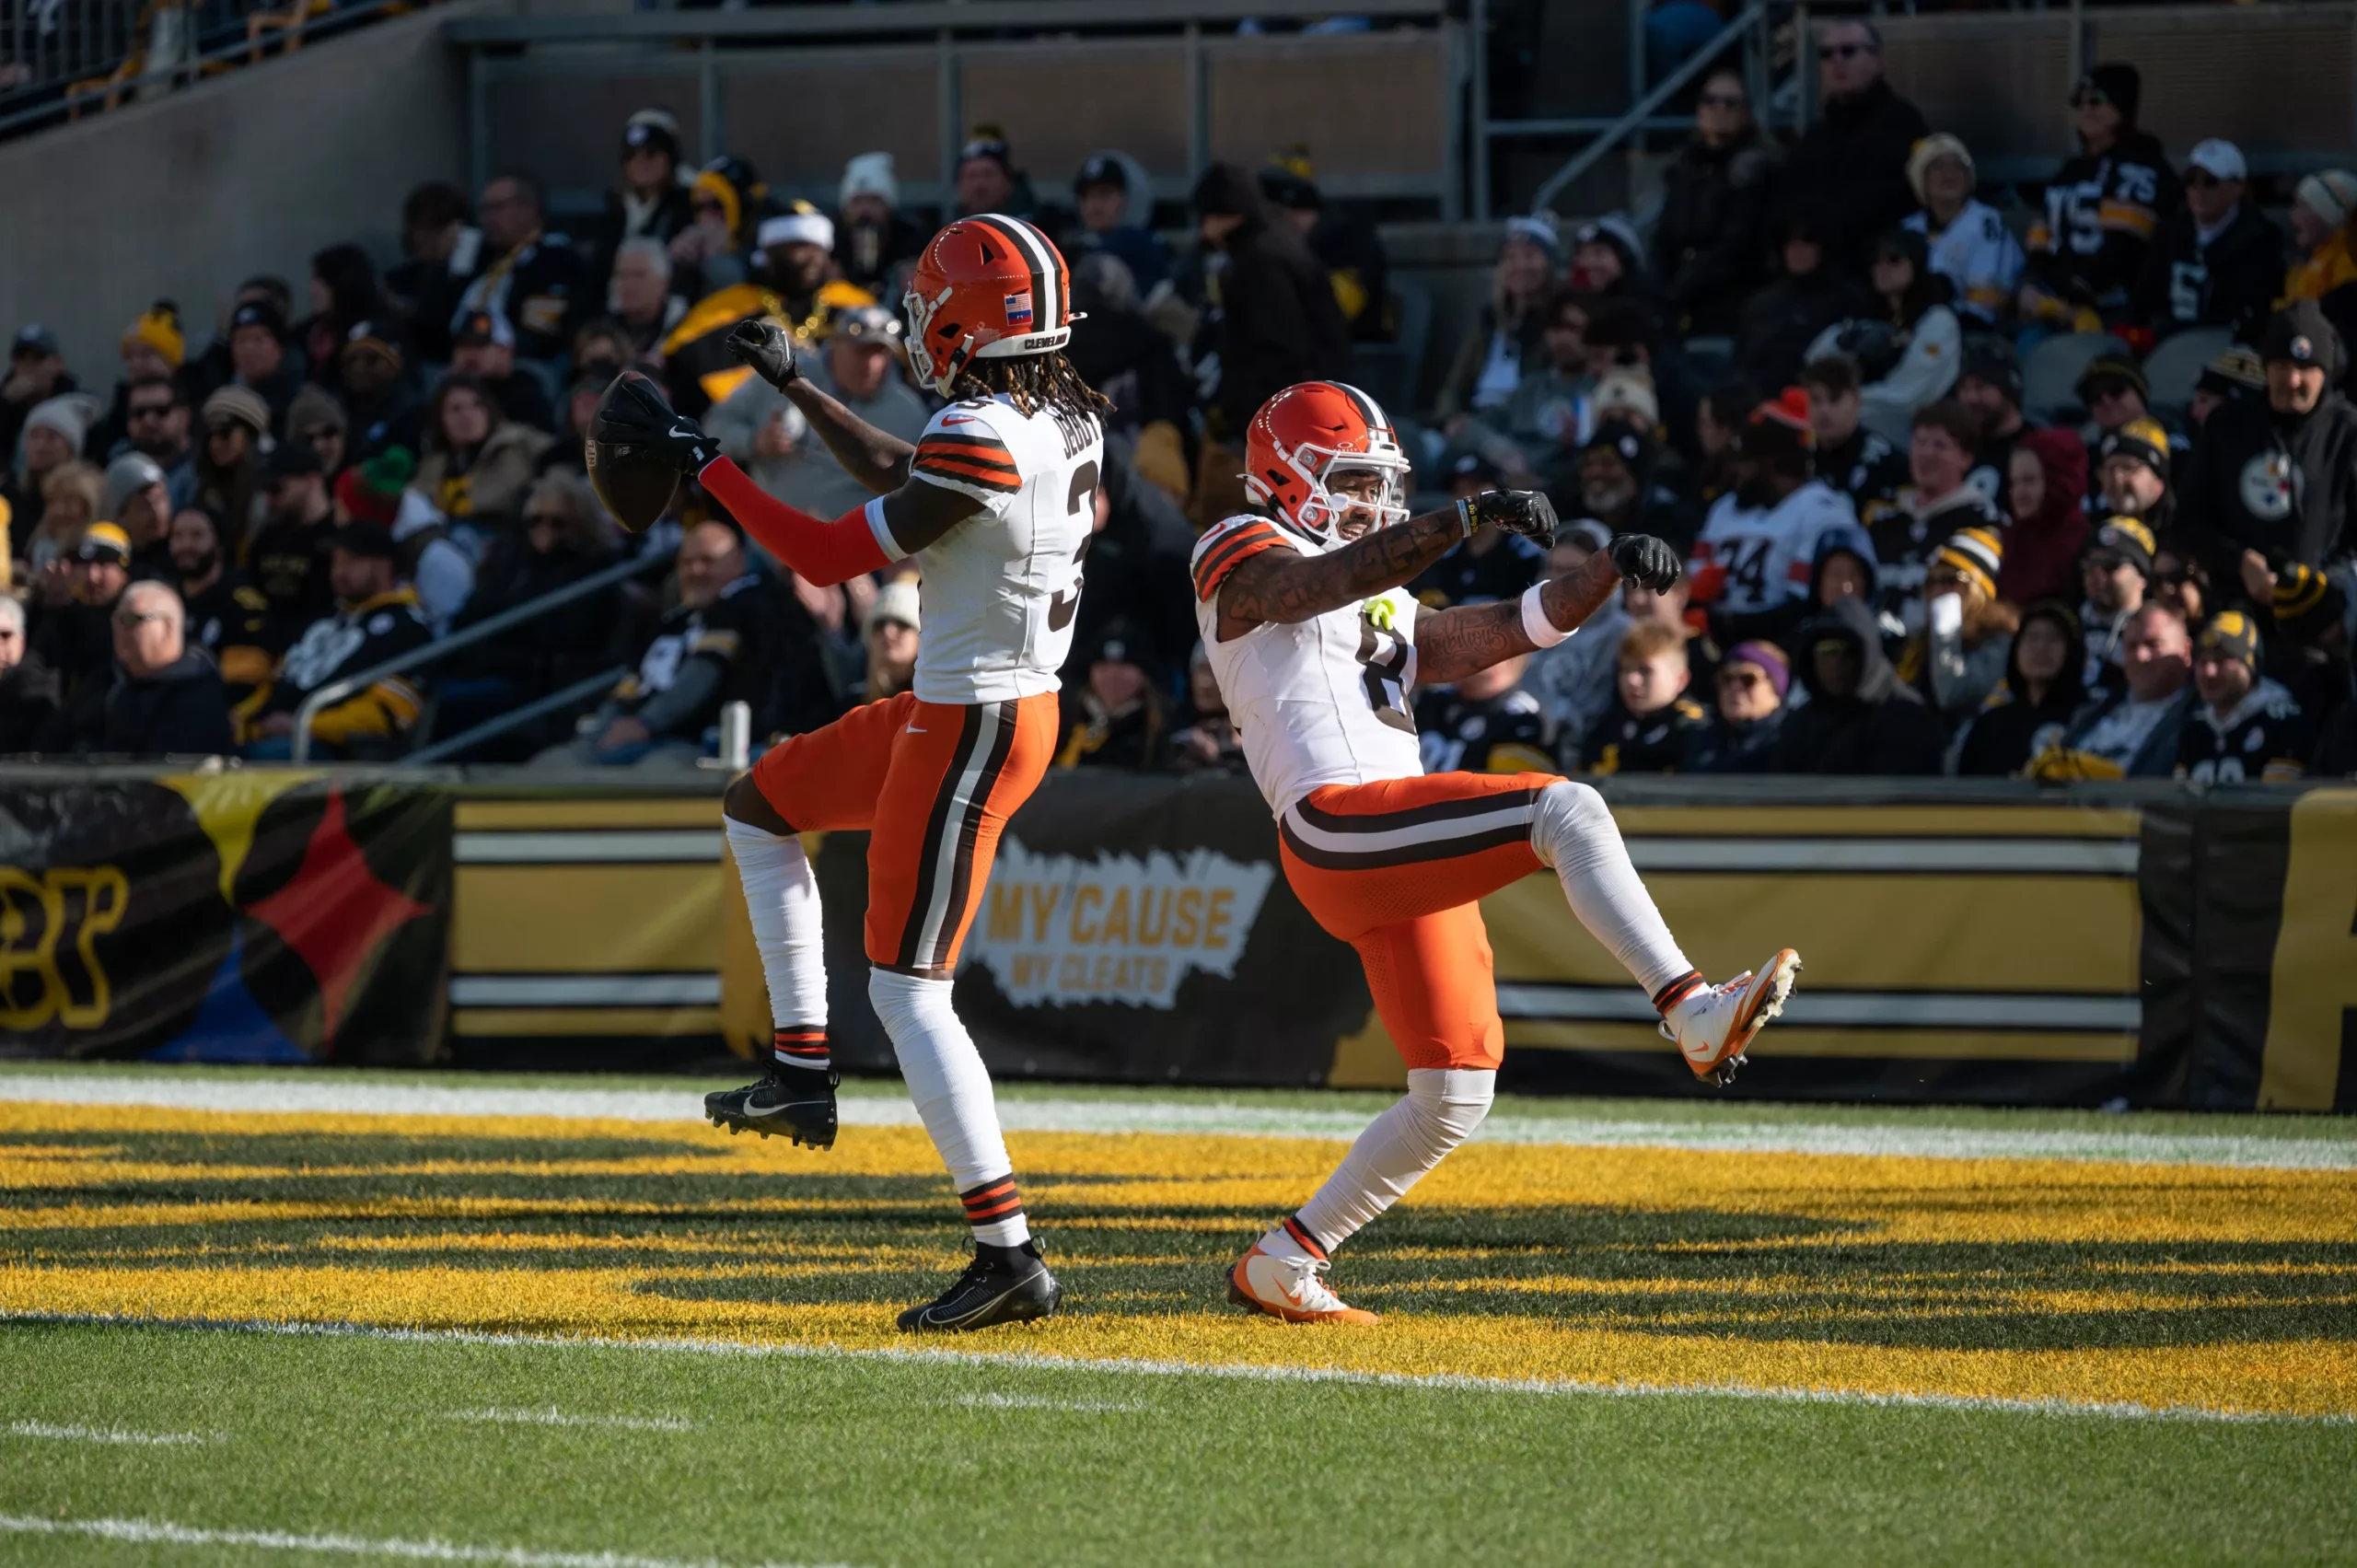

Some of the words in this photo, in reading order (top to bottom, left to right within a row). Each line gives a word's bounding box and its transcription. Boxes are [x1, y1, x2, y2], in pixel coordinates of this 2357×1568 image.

[2043, 180, 2106, 257] 75
[1048, 460, 1098, 633] 3
[1720, 537, 1771, 602] 74
[1355, 611, 1418, 736] 8
[988, 882, 1057, 943] MY
[1070, 884, 1236, 947] CAUSE
[1011, 955, 1054, 988] MY
[1058, 955, 1167, 994] CLEATS
